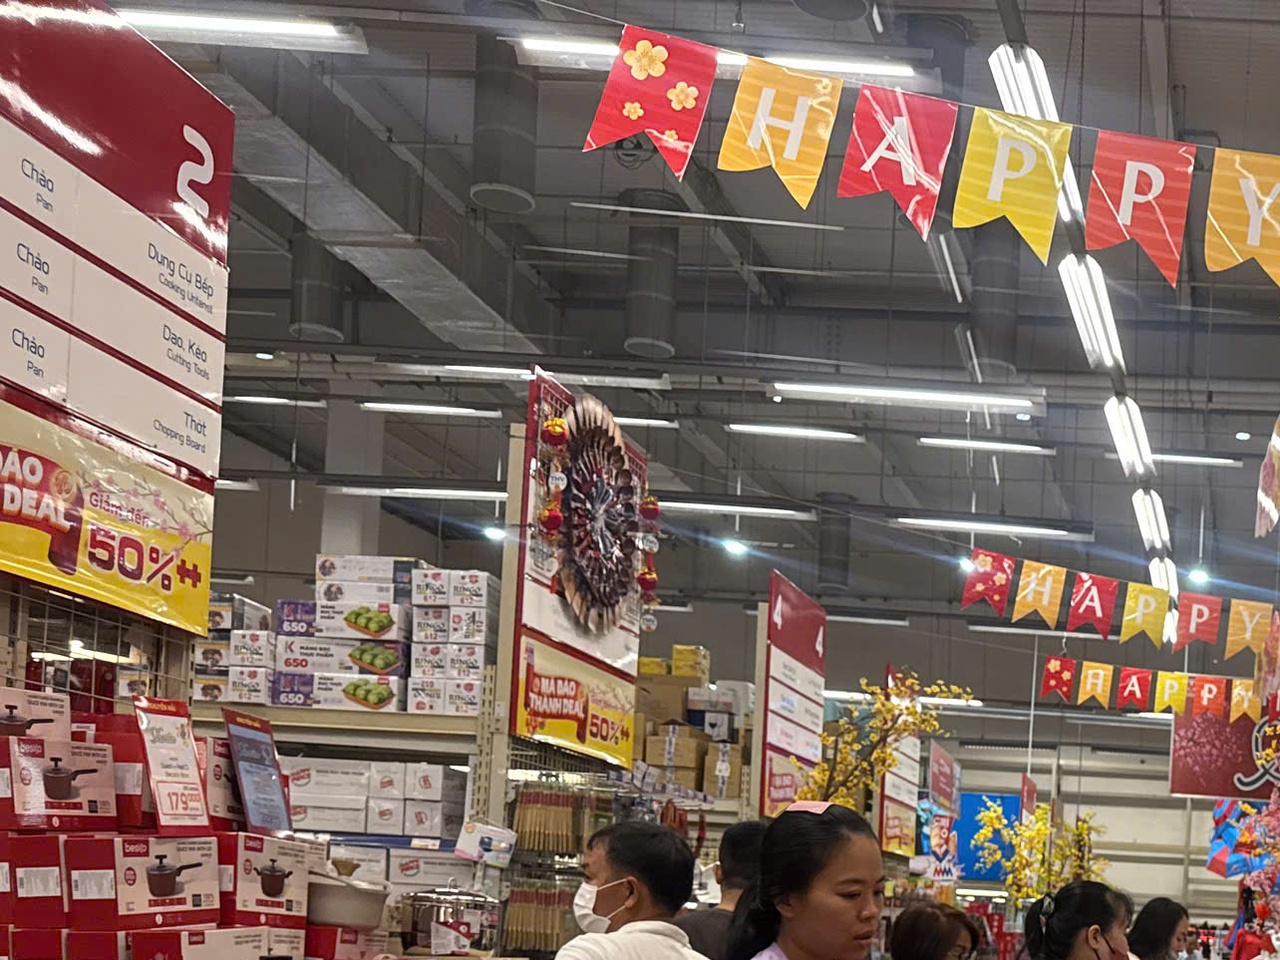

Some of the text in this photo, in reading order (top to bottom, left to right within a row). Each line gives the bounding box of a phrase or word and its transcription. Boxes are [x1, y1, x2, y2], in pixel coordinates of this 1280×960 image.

[177, 124, 214, 218] 2
[36, 192, 53, 213] Pan
[32, 276, 48, 295] Pan
[26, 360, 44, 378] Pan
[167, 348, 210, 381] Cutting Tools
[153, 419, 206, 454] Chopping Board
[3, 483, 73, 531] DEAL
[1026, 573, 1260, 640] HAPPY
[282, 622, 307, 632] 650
[284, 658, 308, 668] 650
[280, 693, 304, 703] 650
